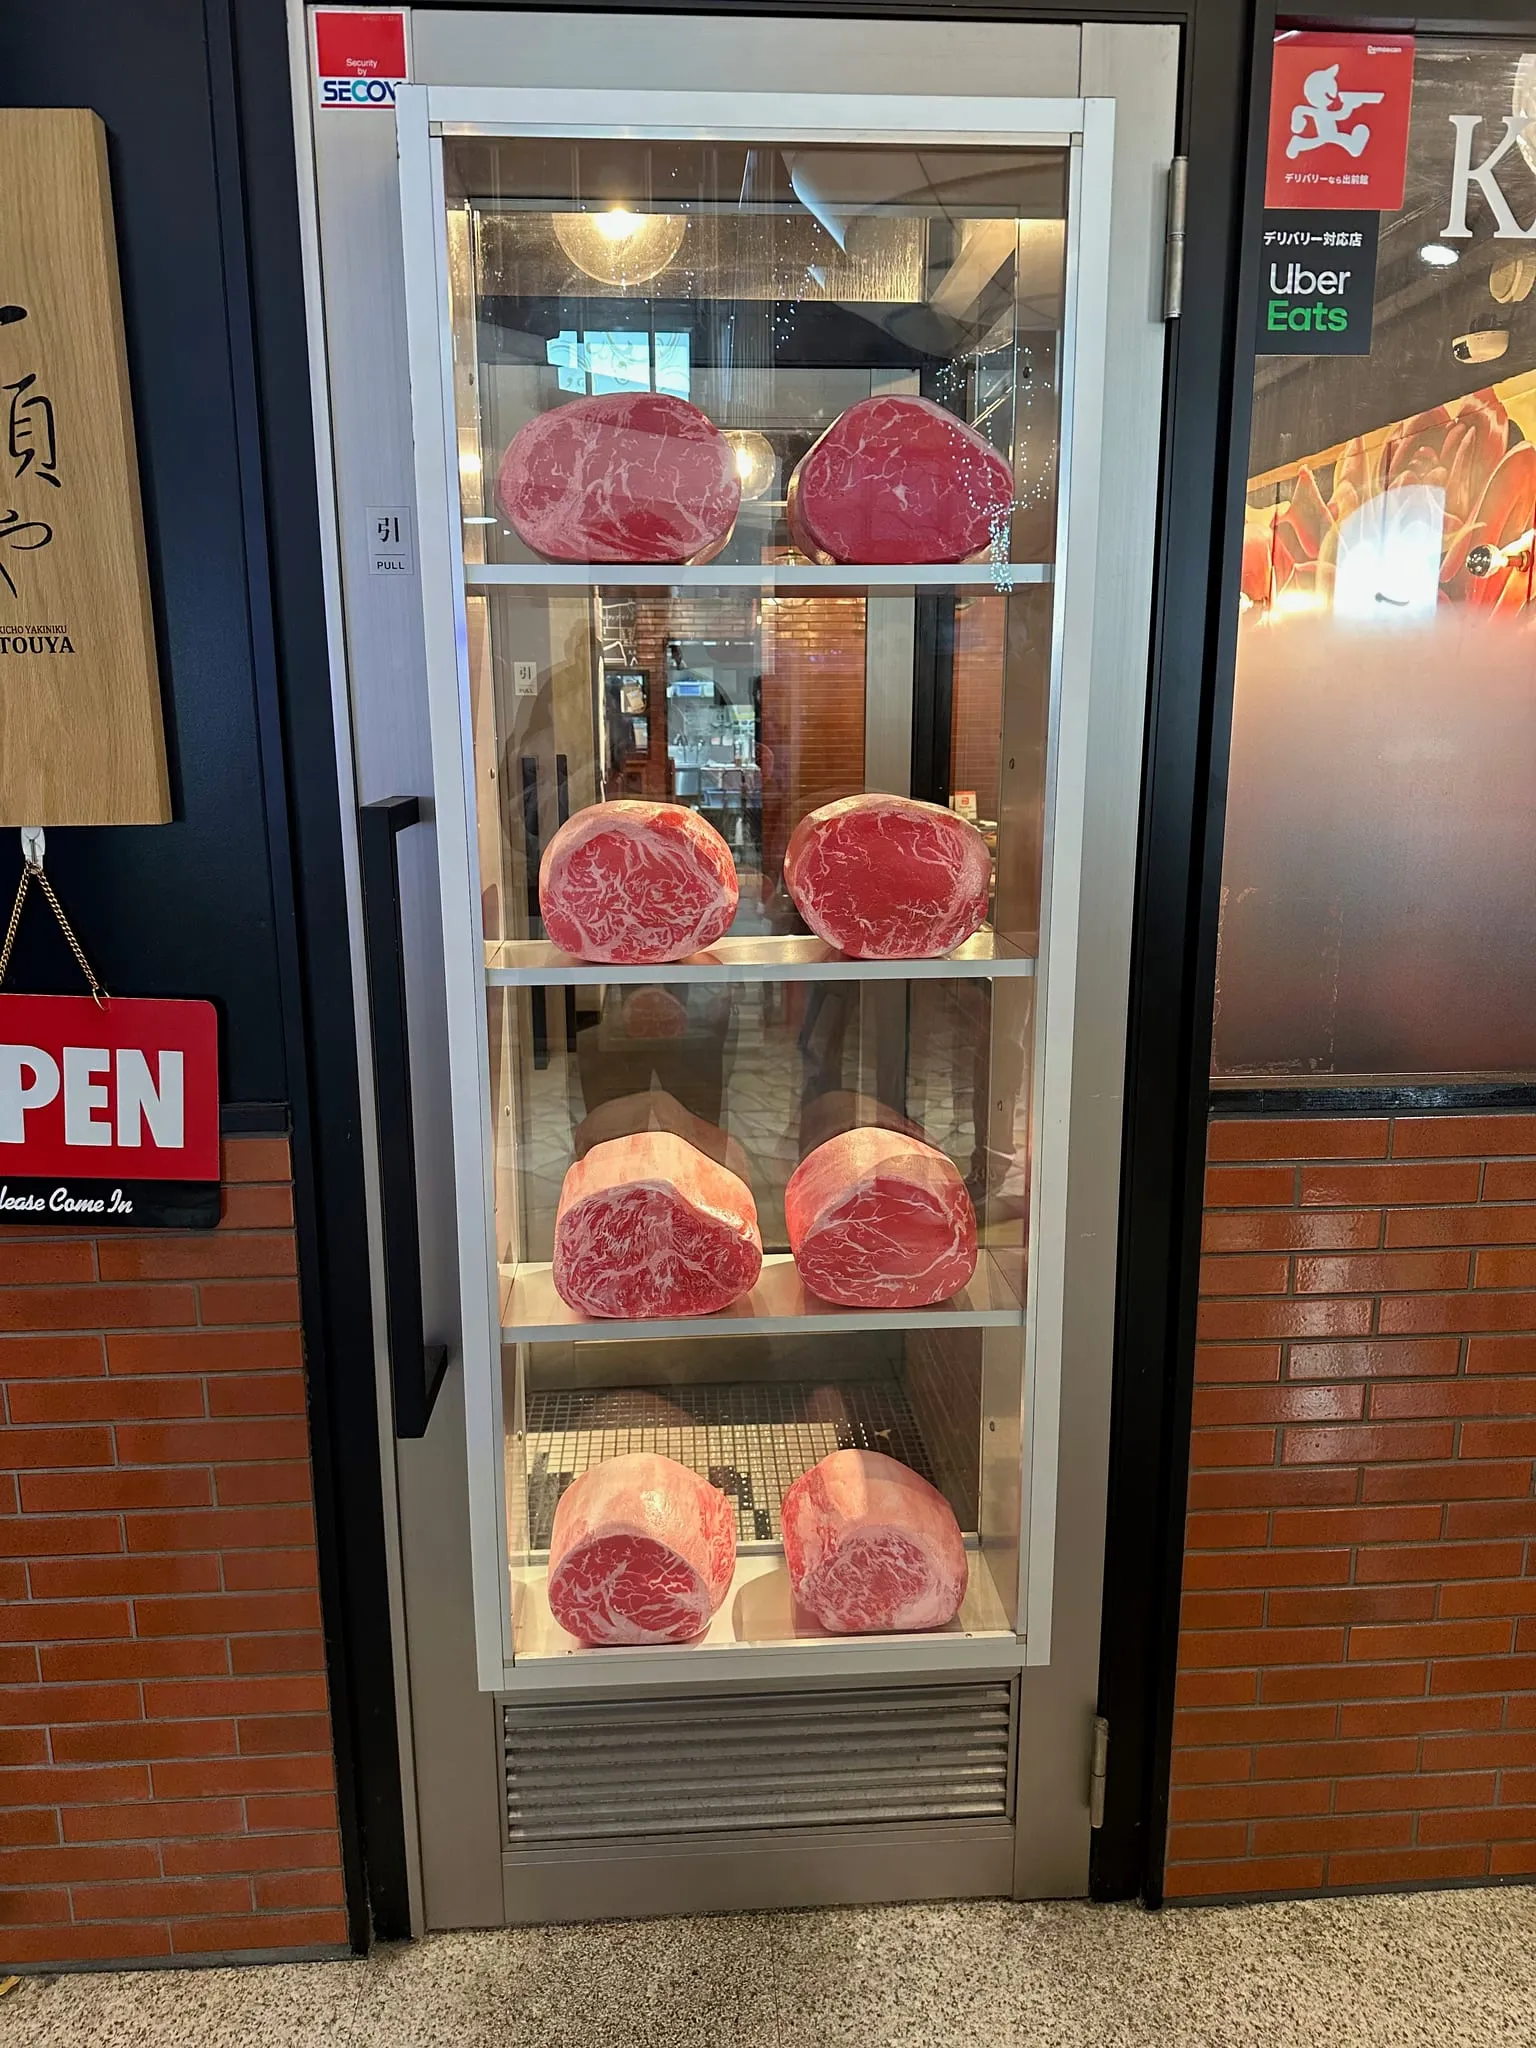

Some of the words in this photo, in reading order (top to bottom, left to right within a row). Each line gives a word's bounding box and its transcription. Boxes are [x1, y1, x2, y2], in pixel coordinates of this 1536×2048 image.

[346, 58, 378, 69] Security
[357, 67, 367, 76] by
[1284, 173, 1369, 185] デリバリーなら出前館
[1263, 231, 1363, 247] デリバリー対応店
[1270, 263, 1351, 294] Uber
[1267, 300, 1348, 331] Eats
[377, 517, 400, 543] 引
[376, 561, 405, 570] PULL
[25, 625, 67, 634] YAKINIKU
[0, 1044, 184, 1148] PEN
[49, 1187, 105, 1212] Come
[107, 1188, 133, 1213] In
